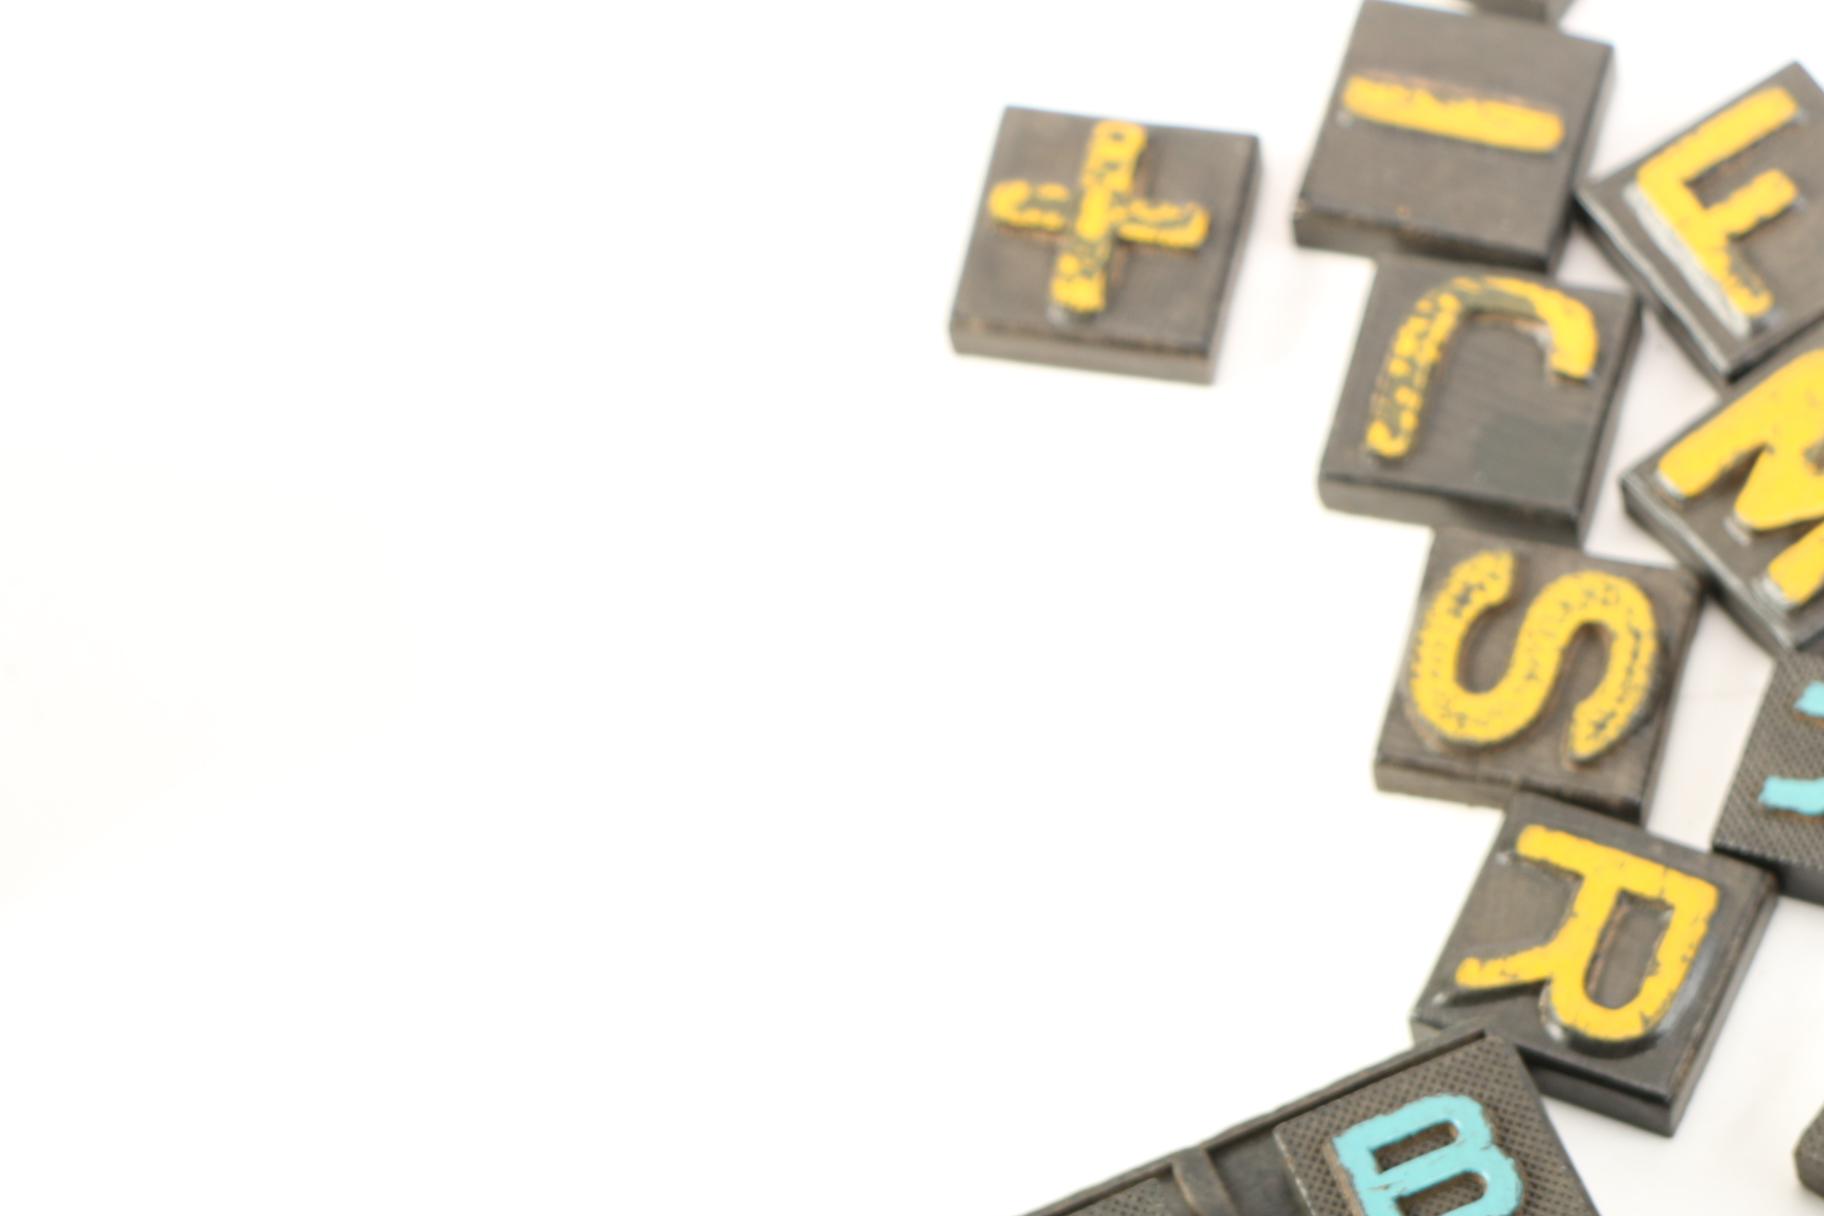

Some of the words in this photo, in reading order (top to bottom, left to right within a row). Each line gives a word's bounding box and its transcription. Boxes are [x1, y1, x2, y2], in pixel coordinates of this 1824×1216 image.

[1637, 89, 1797, 316] F
[1411, 553, 1661, 762] S
[1456, 824, 1720, 1042] R
